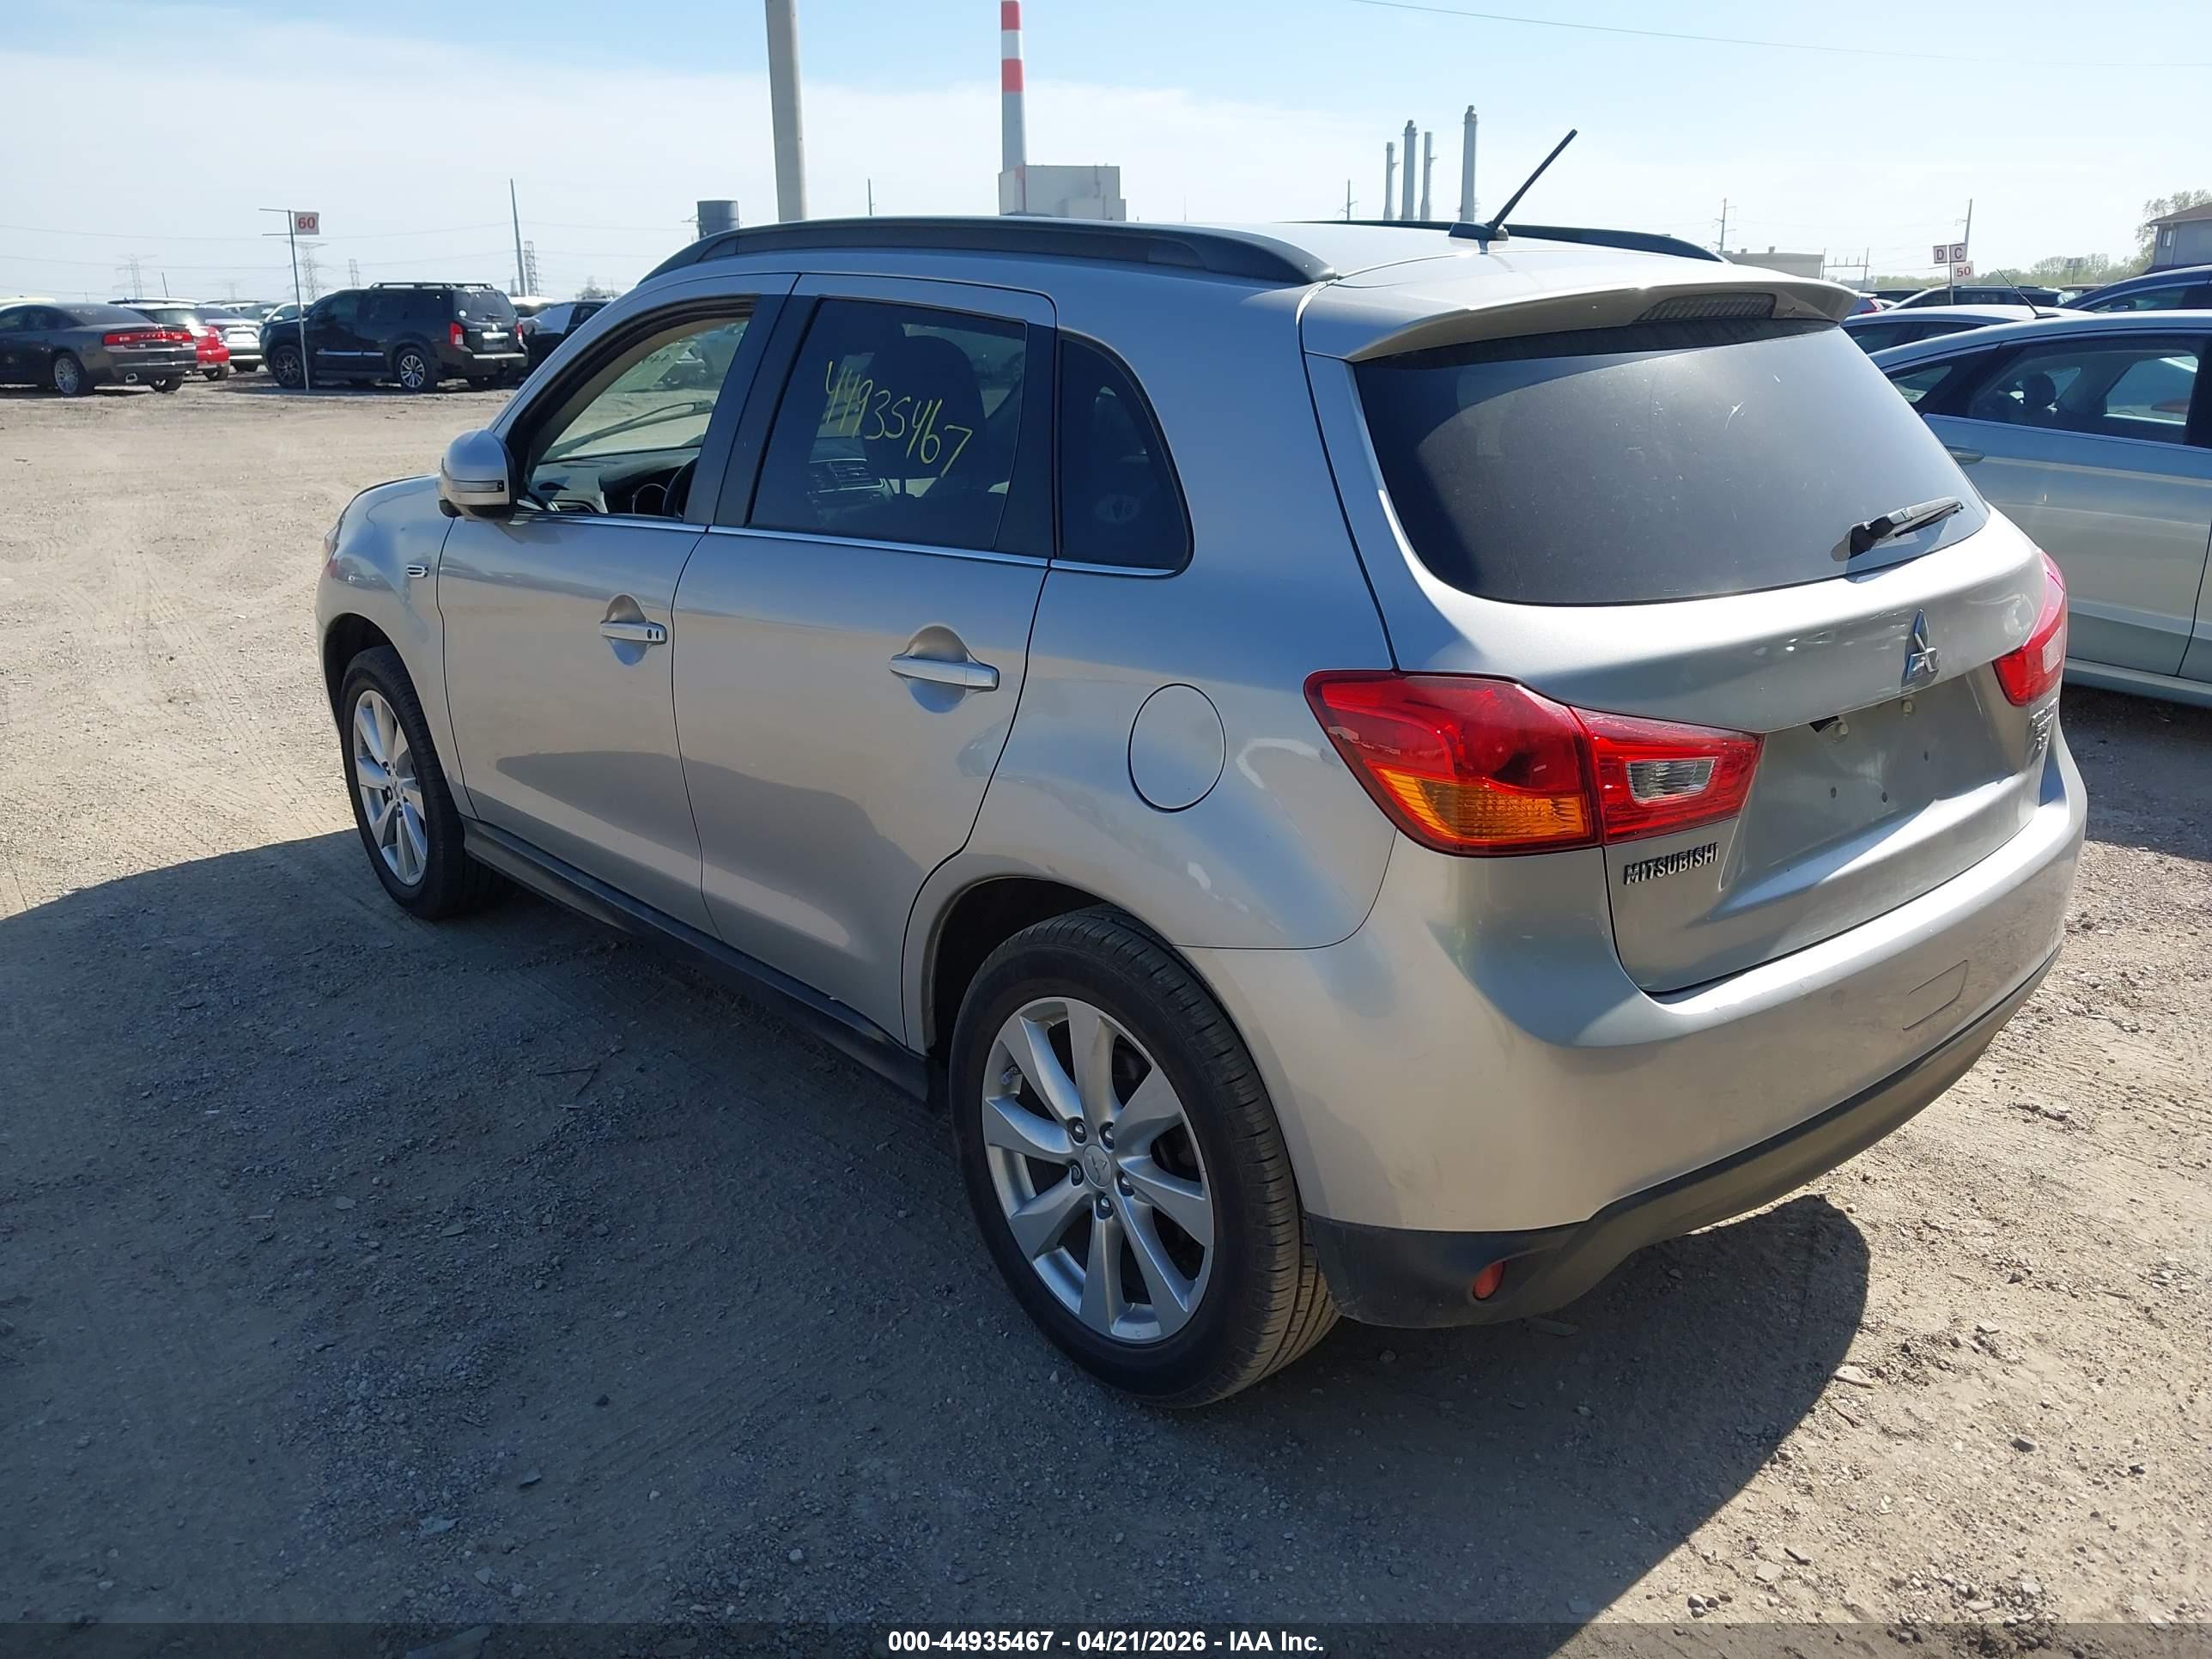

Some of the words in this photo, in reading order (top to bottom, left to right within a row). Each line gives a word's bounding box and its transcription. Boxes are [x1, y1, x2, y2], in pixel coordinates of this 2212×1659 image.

[298, 216, 315, 229] 60
[1936, 249, 1945, 260] D
[1954, 247, 1963, 259] C
[1956, 266, 1972, 276] 50
[825, 360, 974, 478] 44935467
[1624, 842, 1719, 885] MITSUBISHI
